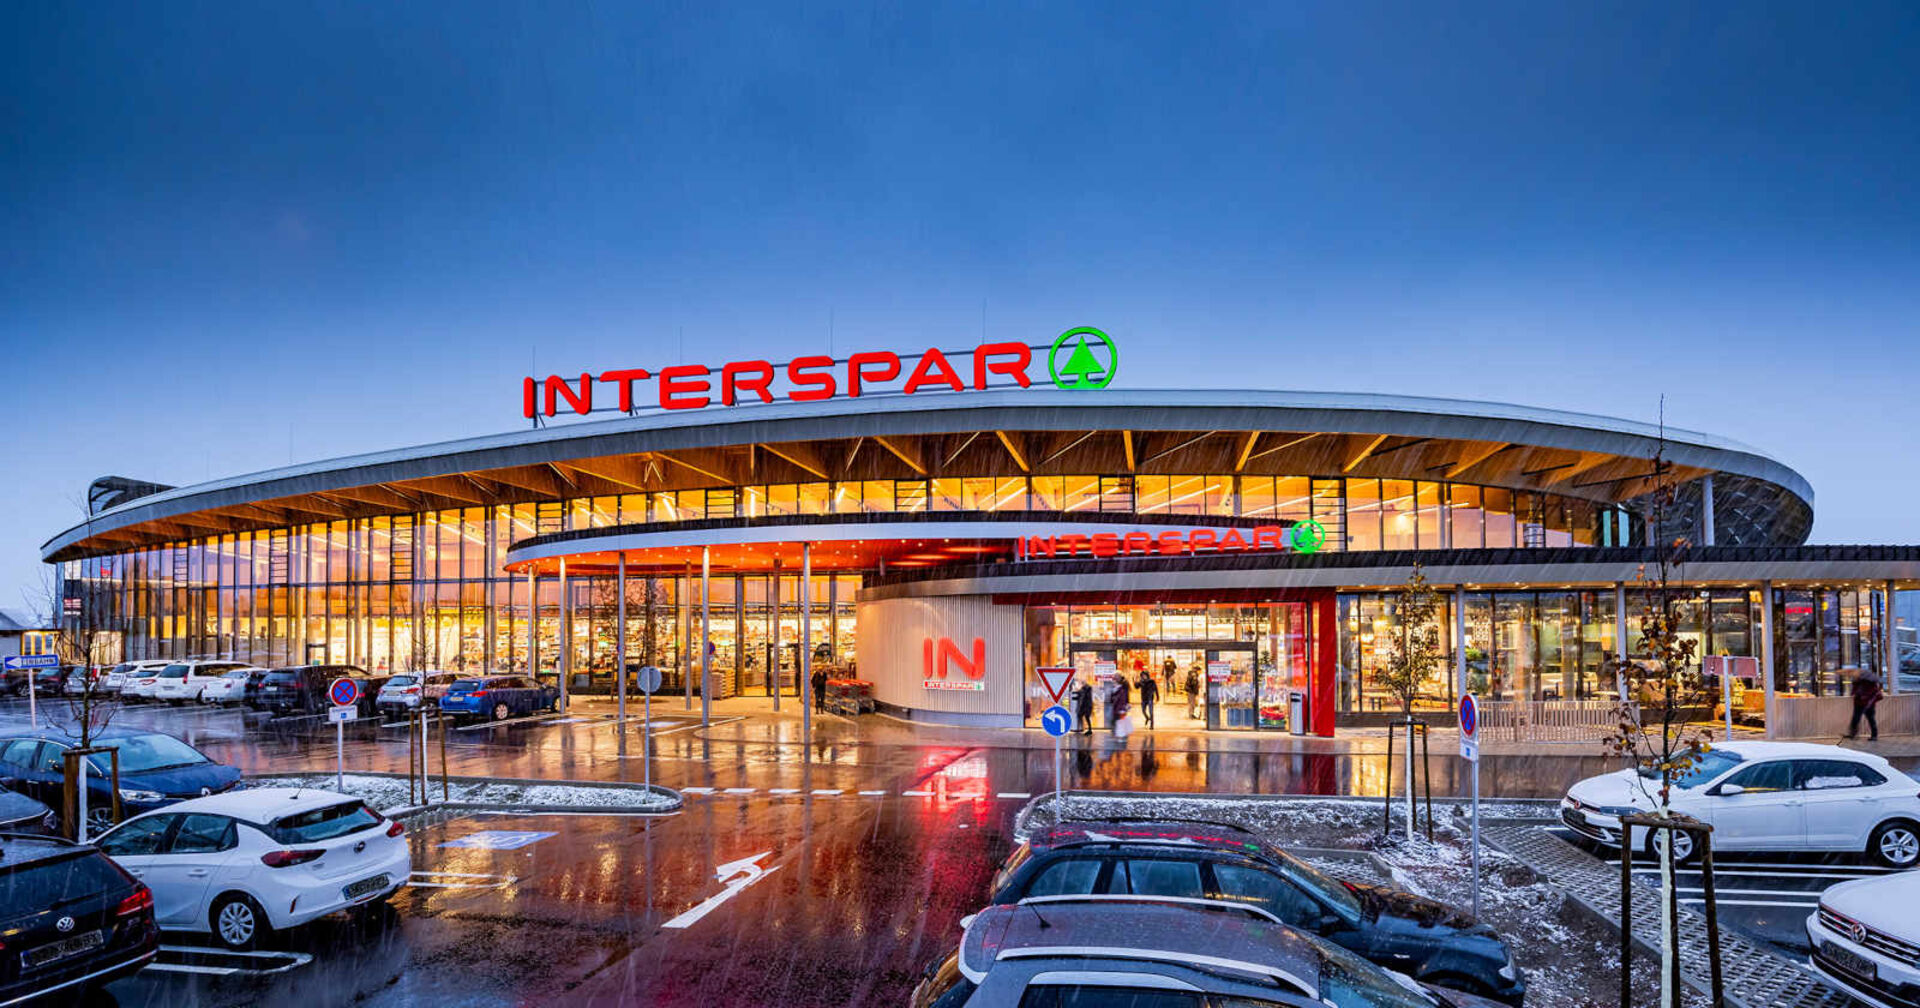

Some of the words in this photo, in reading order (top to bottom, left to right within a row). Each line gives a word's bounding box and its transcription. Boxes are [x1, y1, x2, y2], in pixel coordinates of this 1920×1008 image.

[523, 342, 1032, 418] INTERSPAR
[1018, 525, 1283, 557] INTERSPAR
[923, 637, 985, 680] IN
